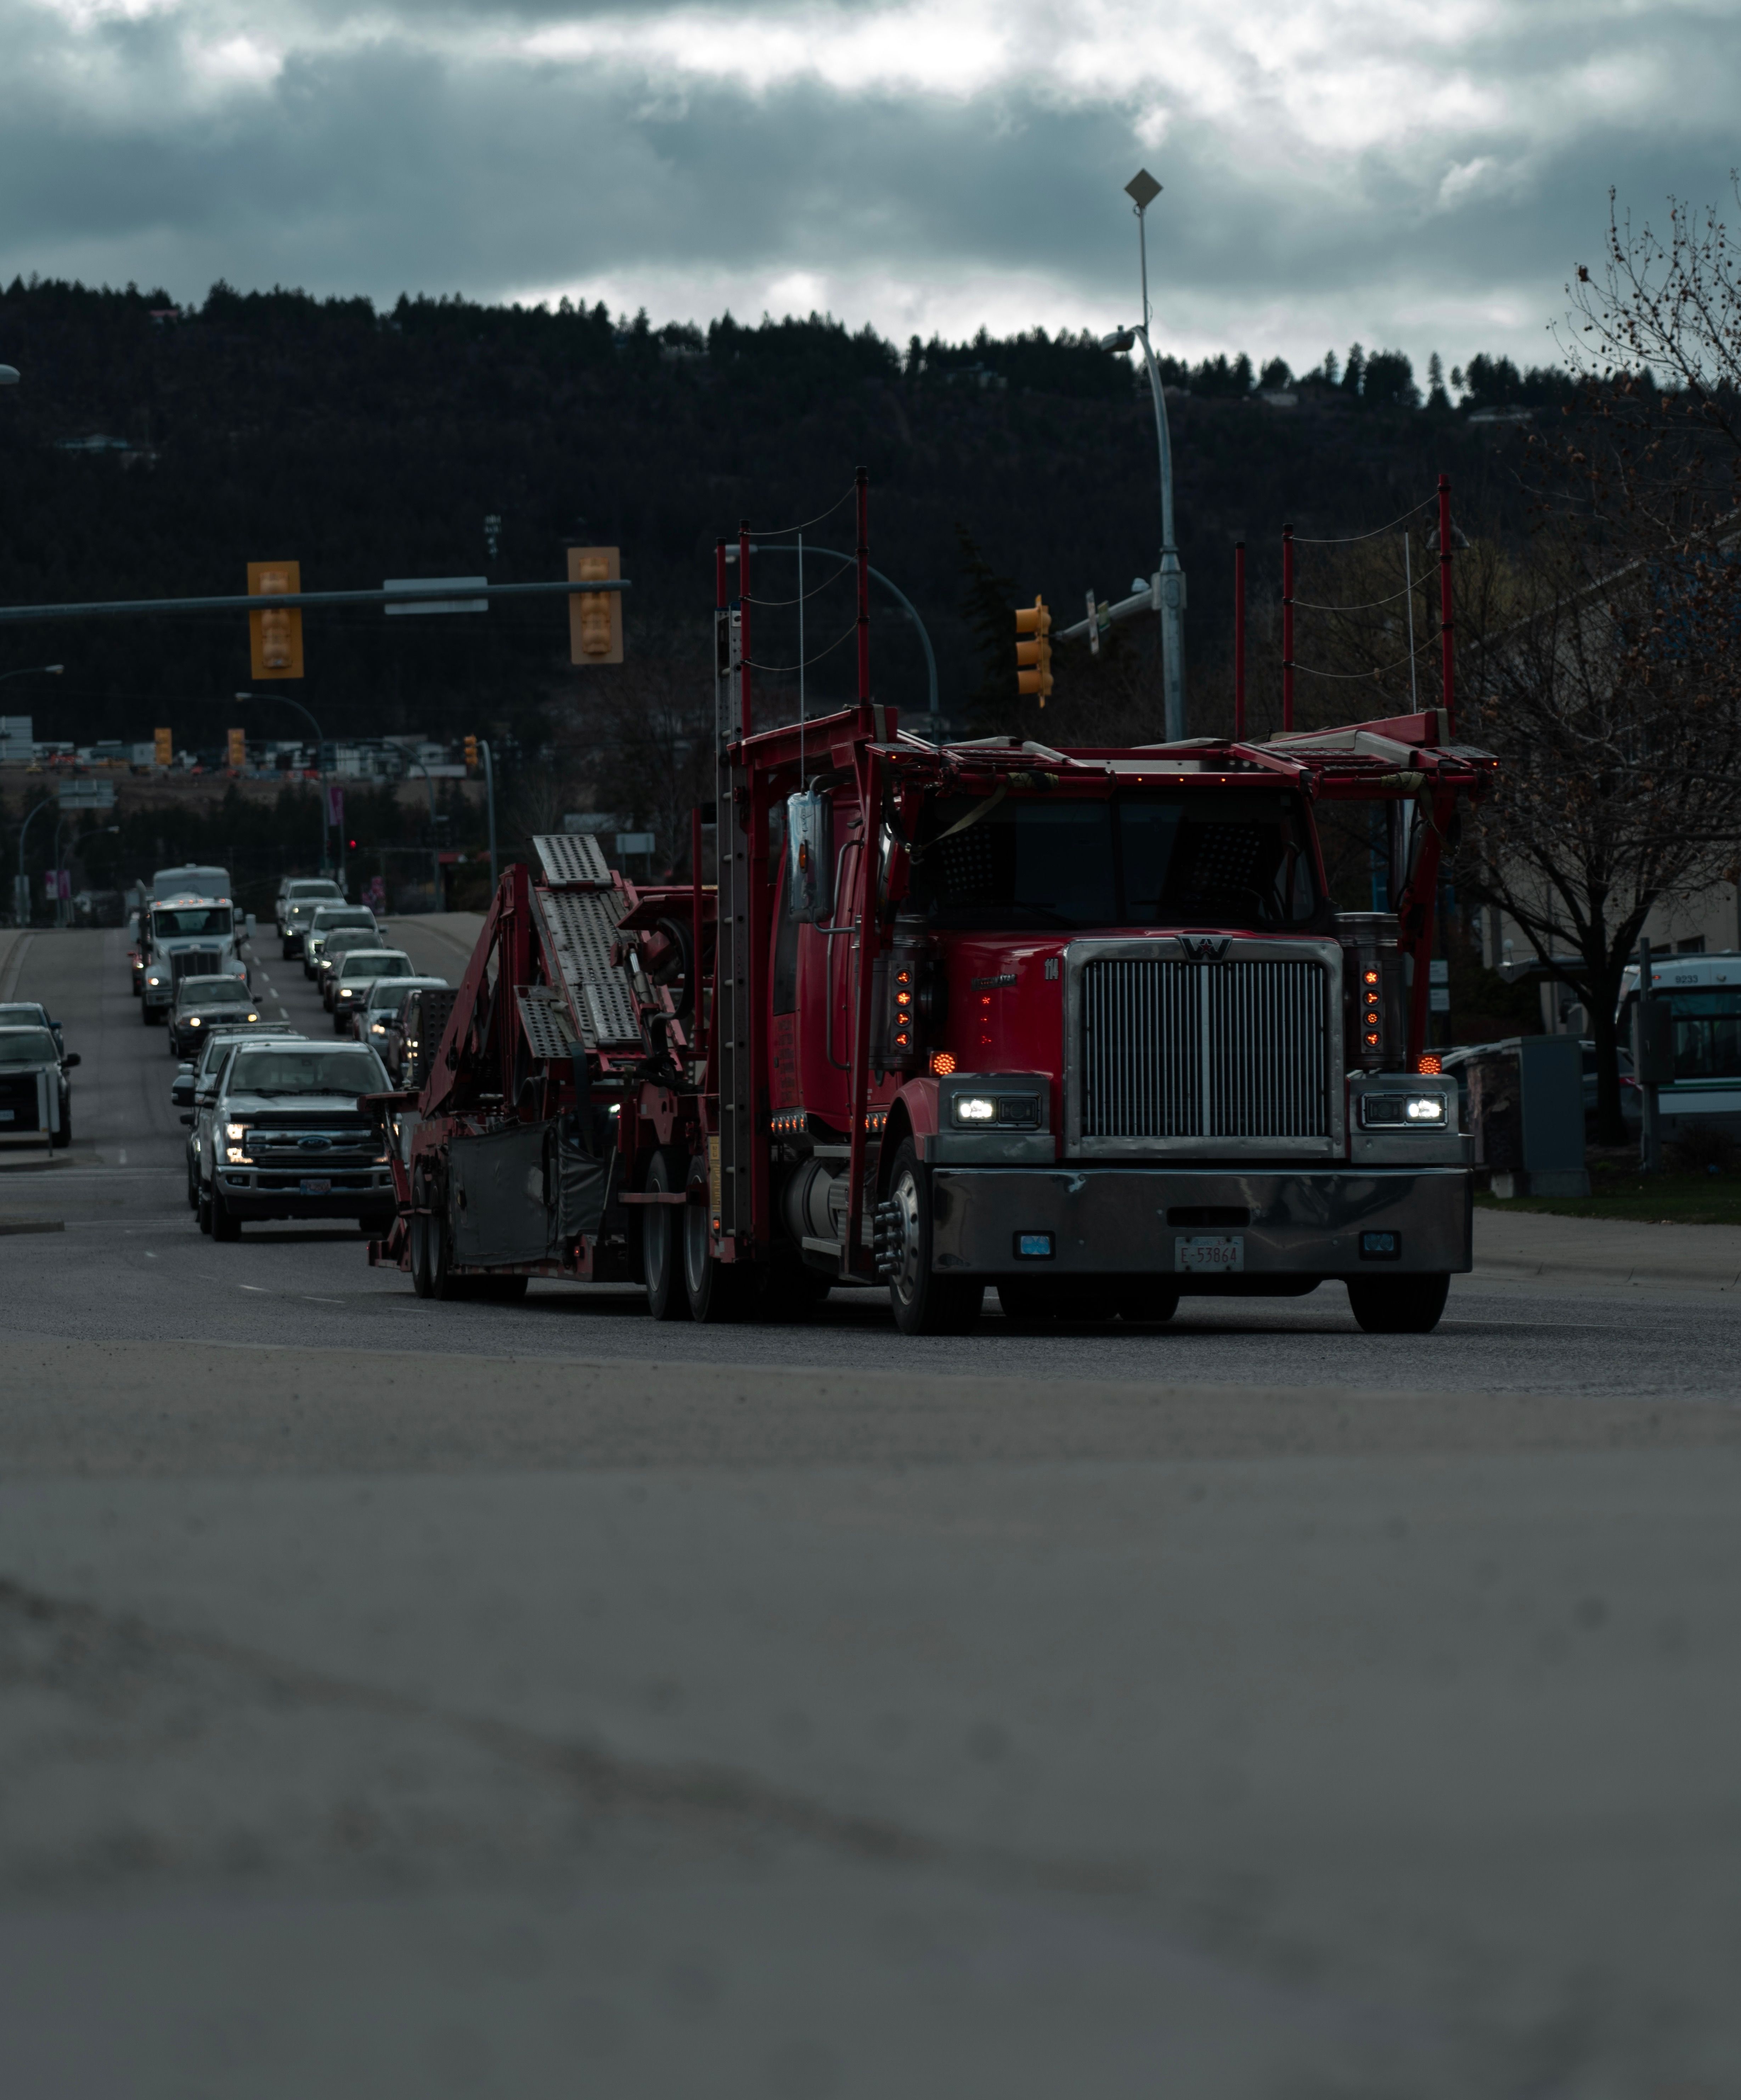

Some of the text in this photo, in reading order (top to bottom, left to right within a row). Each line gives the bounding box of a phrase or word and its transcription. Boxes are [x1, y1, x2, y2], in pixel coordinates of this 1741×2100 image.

[1044, 958, 1059, 980] 114
[1675, 975, 1698, 983] 9233
[1181, 1247, 1236, 1263] E-53864
